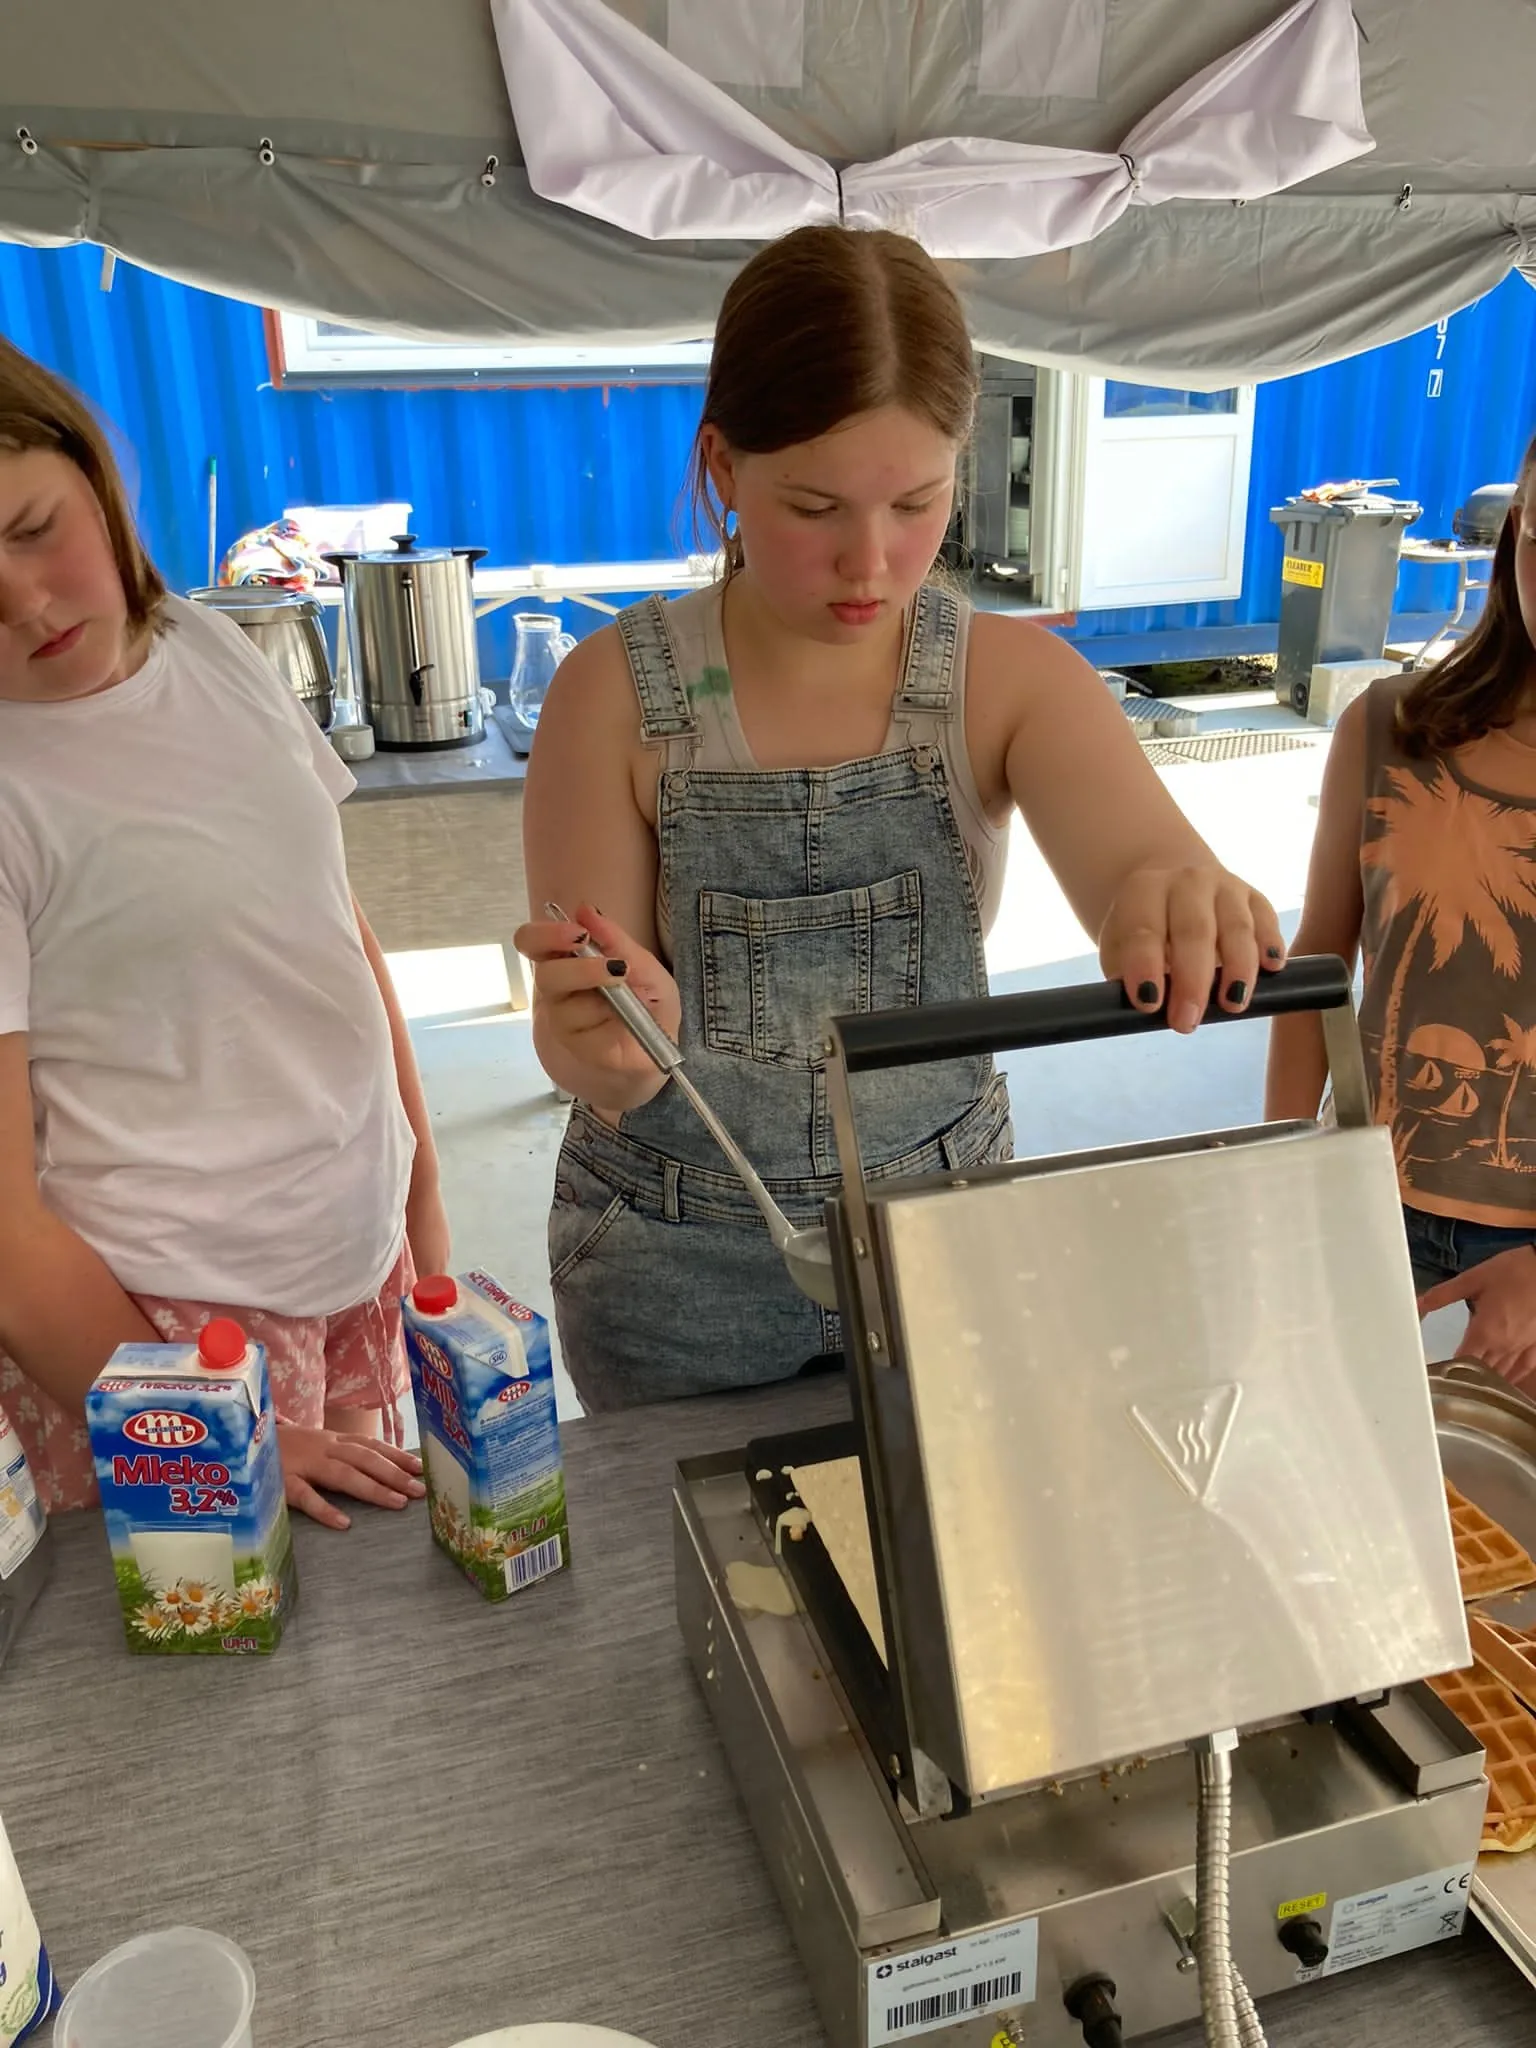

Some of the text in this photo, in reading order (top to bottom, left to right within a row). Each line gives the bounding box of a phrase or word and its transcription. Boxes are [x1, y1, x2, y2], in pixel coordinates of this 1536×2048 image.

[422, 1362, 458, 1418] Milk
[113, 1455, 231, 1486] Mleko
[170, 1488, 239, 1515] 3,2%
[1283, 1897, 1321, 1913] RESET
[896, 1946, 958, 1973] stalgast
